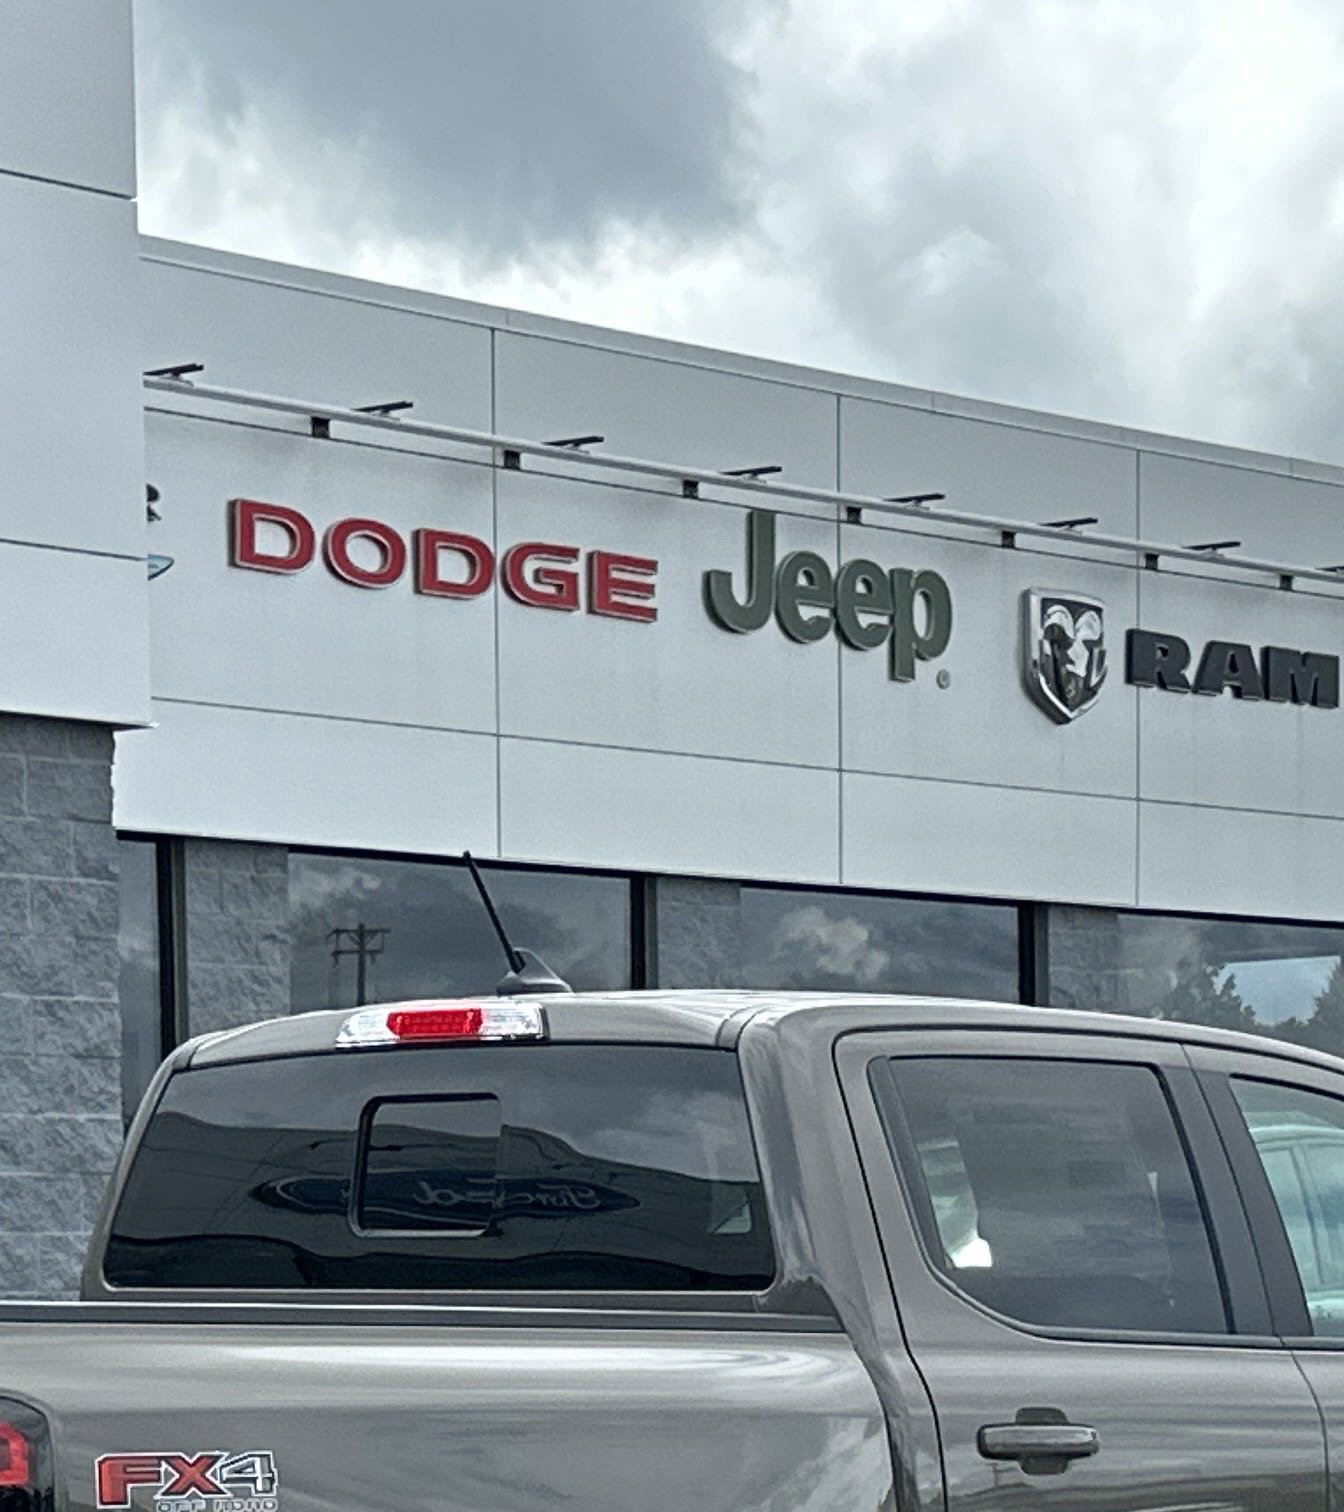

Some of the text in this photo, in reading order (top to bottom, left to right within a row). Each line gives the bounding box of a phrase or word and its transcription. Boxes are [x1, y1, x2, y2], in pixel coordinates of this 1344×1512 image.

[227, 498, 659, 623] DODGE
[703, 508, 954, 683] Jeep
[1124, 626, 1341, 709] RAM
[95, 1451, 278, 1509] FX4
